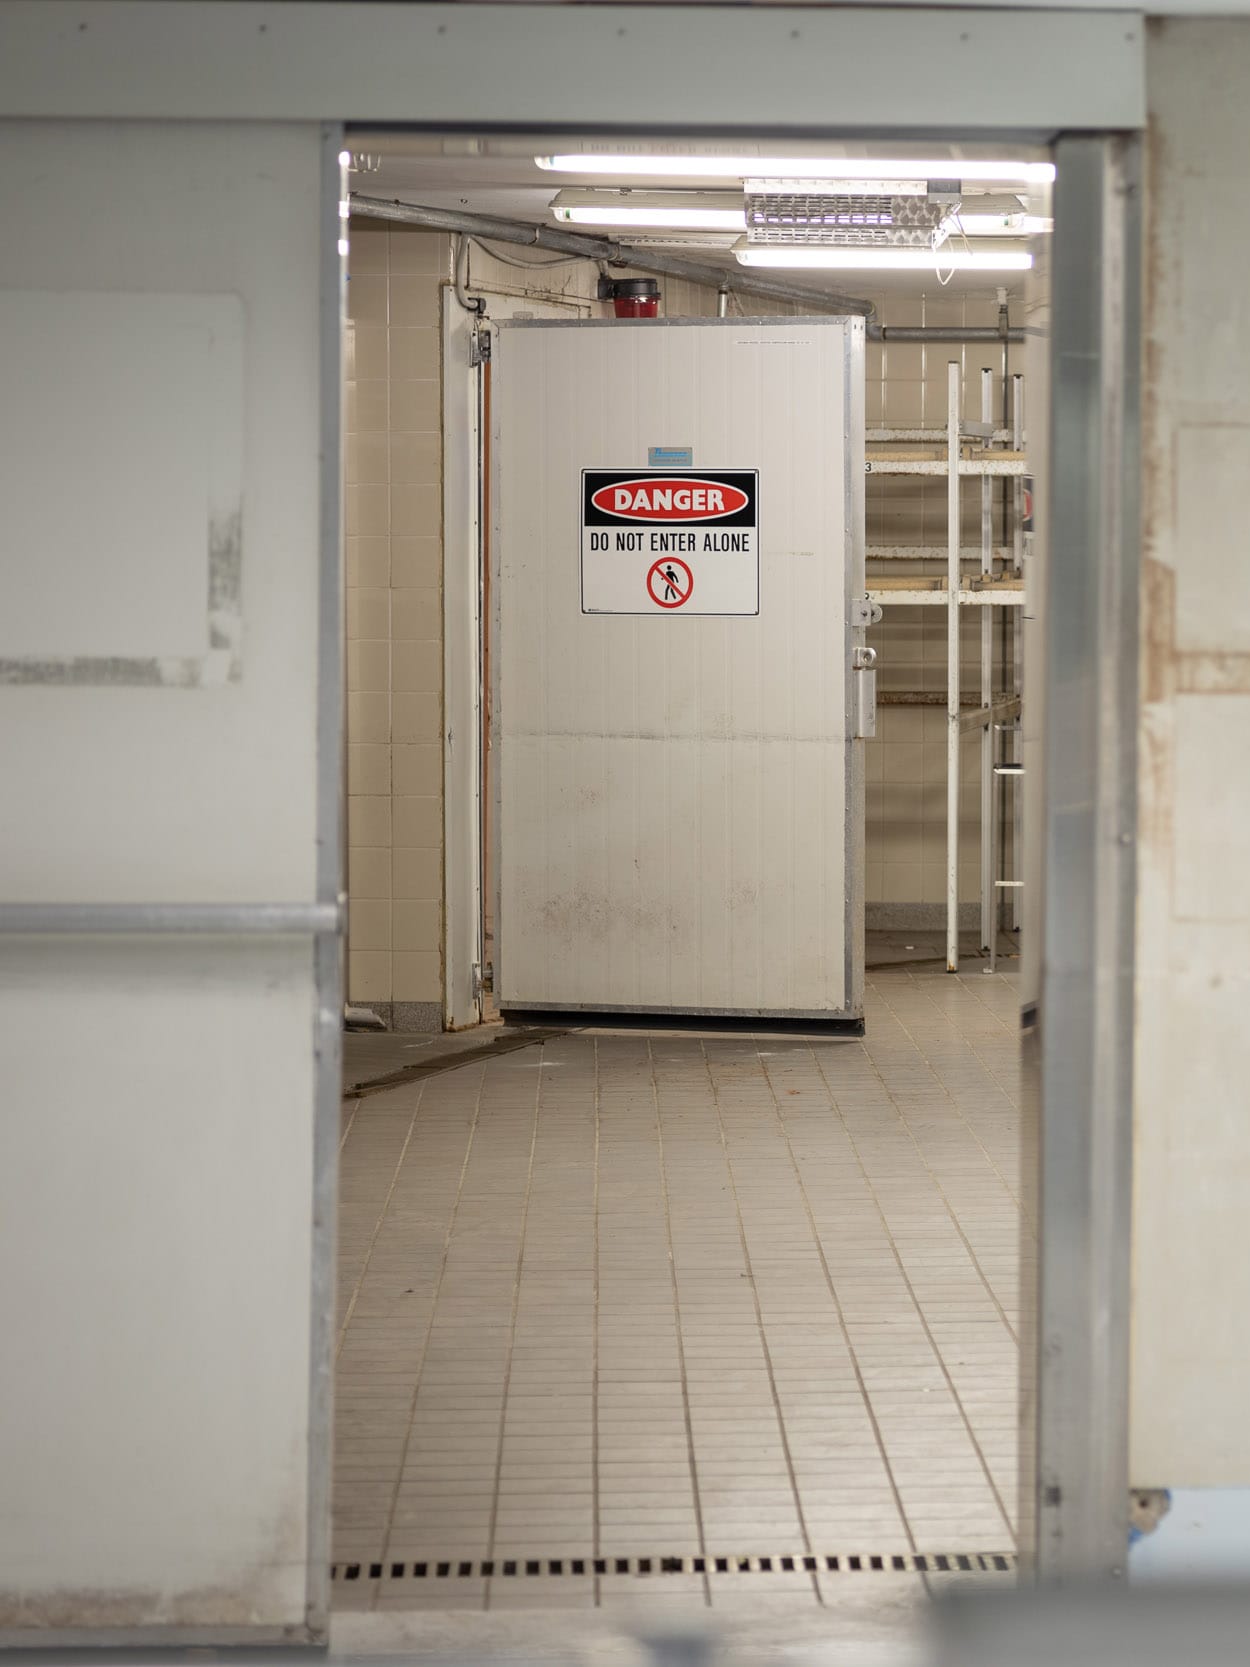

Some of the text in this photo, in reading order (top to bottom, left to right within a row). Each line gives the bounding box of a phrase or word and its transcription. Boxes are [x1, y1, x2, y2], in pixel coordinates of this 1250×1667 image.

[614, 488, 725, 511] DANGER
[590, 532, 750, 552] DO NOT ENTER ALONE
